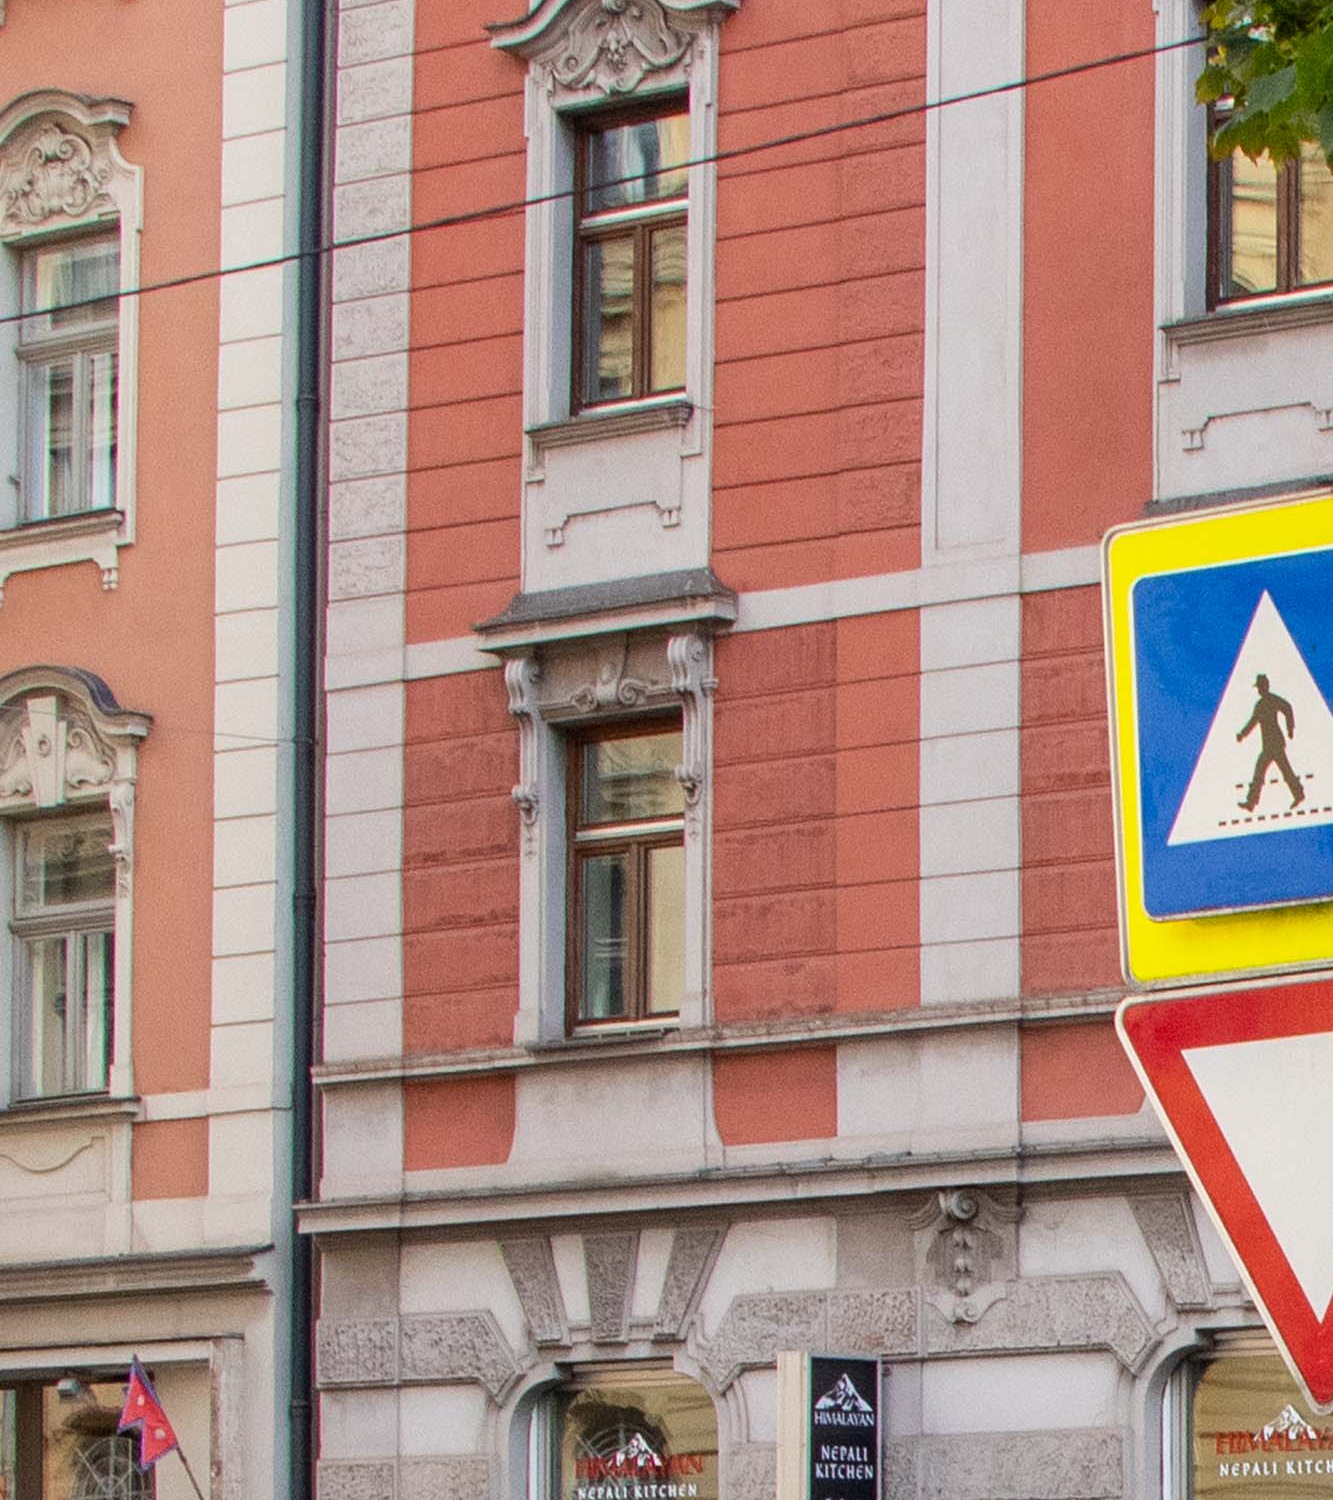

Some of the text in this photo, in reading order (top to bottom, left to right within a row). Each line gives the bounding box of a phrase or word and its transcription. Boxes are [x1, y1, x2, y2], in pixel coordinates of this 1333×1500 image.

[815, 1412, 874, 1426] HIMALAYAN
[821, 1446, 868, 1461] NEPALI
[816, 1464, 874, 1479] KITCHEN
[1219, 1463, 1278, 1477] NEPALI
[578, 1483, 698, 1500] NEPALI KITCHEN
